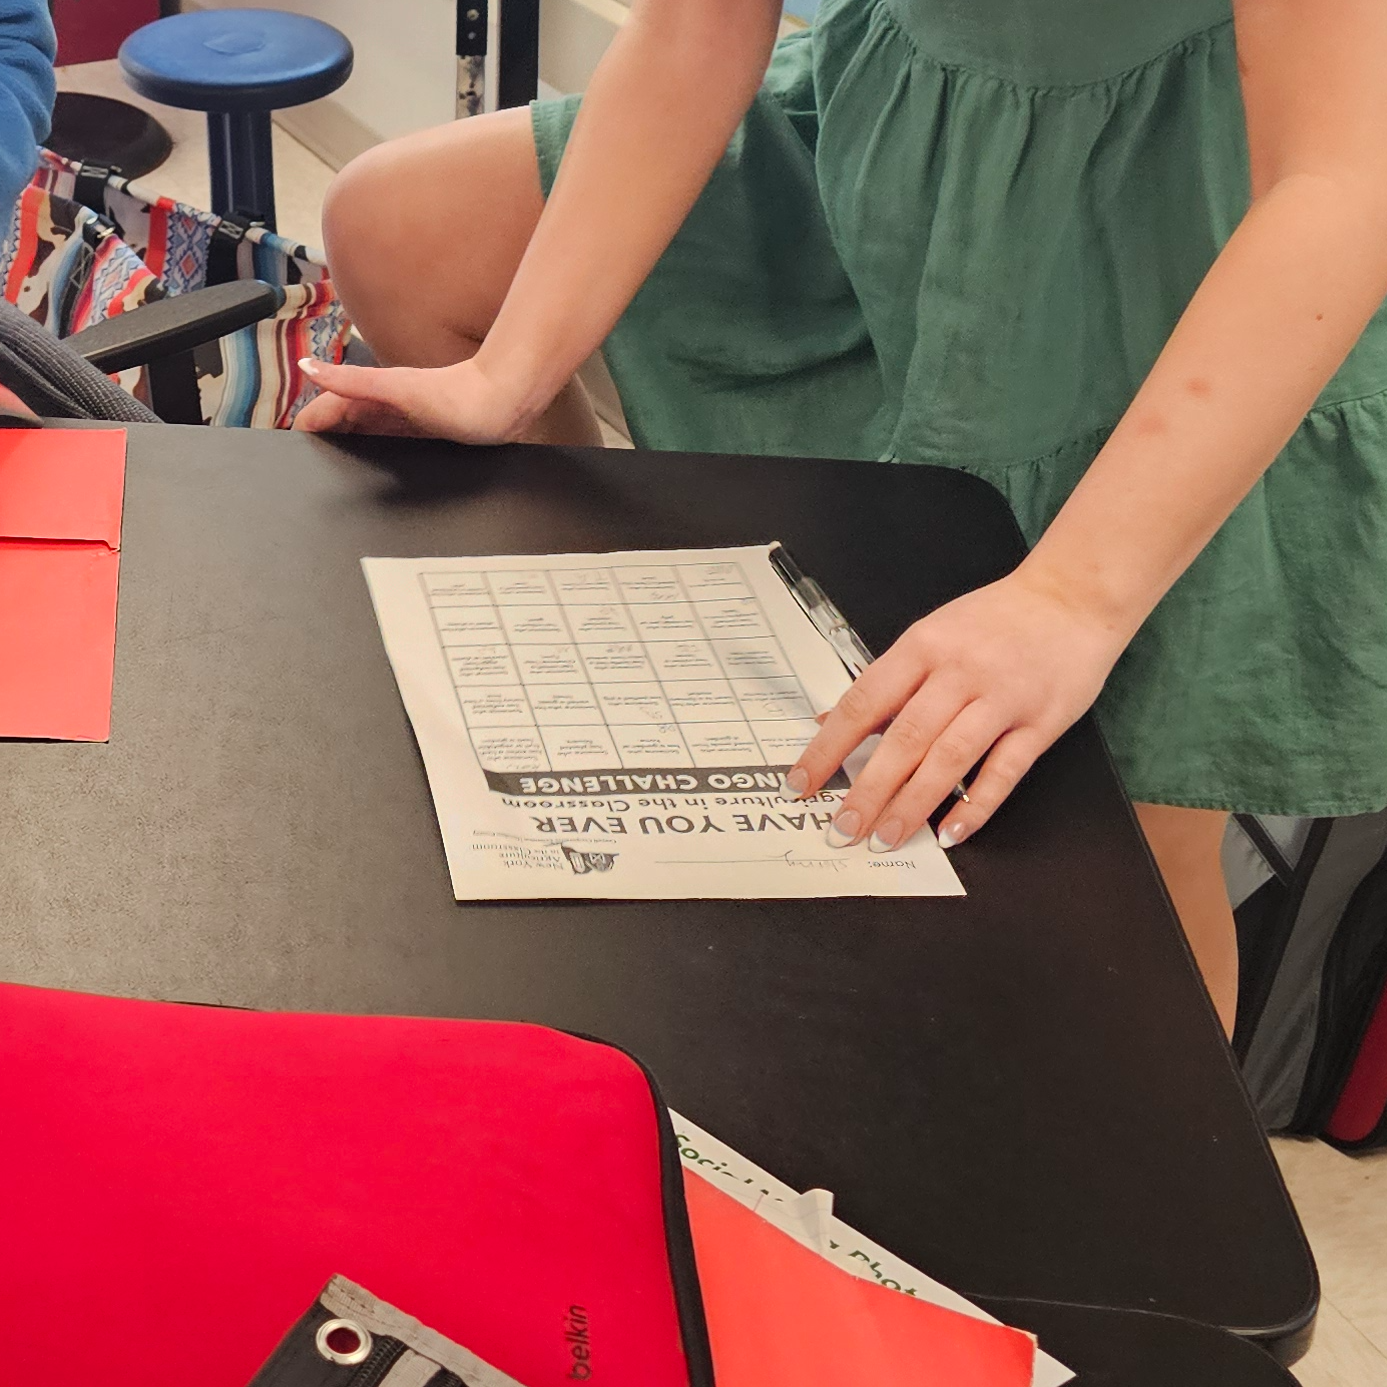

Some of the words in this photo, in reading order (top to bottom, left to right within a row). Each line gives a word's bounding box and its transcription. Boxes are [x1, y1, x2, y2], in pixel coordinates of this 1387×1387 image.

[516, 772, 702, 794] CHALLENGE
[703, 771, 792, 789] INGO
[500, 795, 632, 813] Classroom
[636, 797, 679, 810] the
[683, 797, 709, 809] in
[528, 815, 628, 835] EVER
[634, 814, 725, 834] YOU
[730, 811, 840, 832] HAVE
[864, 859, 917, 869] Name:
[563, 1304, 591, 1381] belkin
